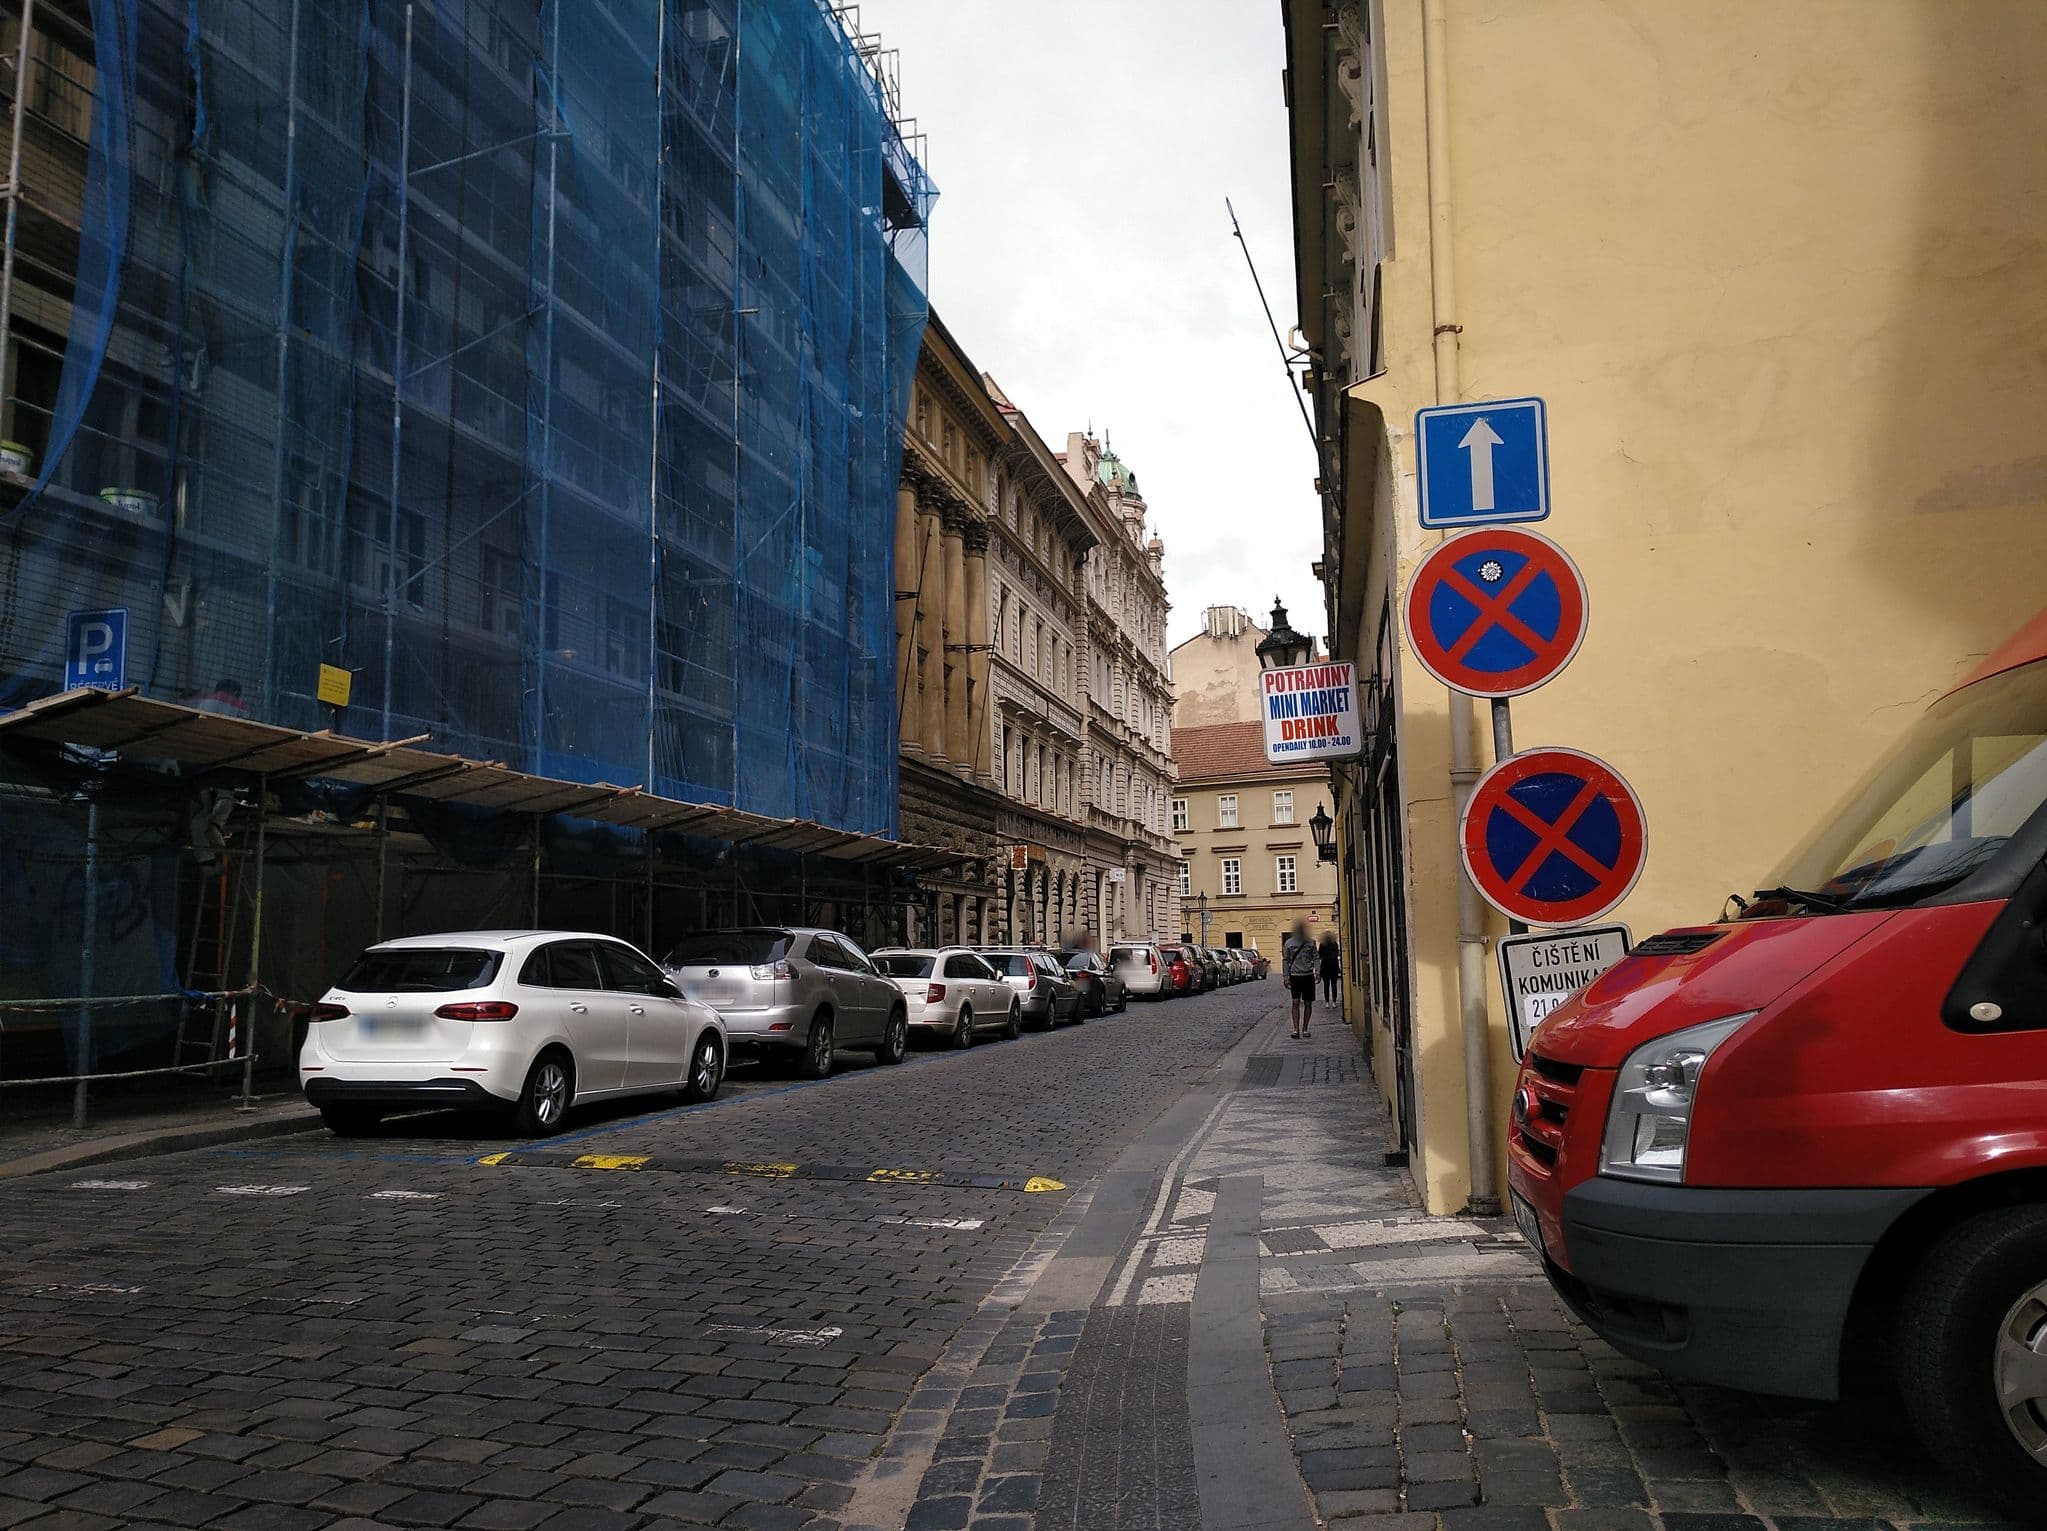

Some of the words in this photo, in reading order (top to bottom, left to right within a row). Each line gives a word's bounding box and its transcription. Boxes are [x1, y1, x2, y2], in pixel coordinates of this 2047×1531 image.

[1265, 665, 1350, 693] POTRAVINY
[1269, 694, 1298, 720] MINI
[1300, 687, 1349, 716] MARKET
[1281, 715, 1340, 740] DRINK
[1332, 736, 1350, 746] 24.00
[1532, 938, 1600, 968] ČIŠTĚNÍ
[1518, 966, 1608, 995] KOMUNIKA
